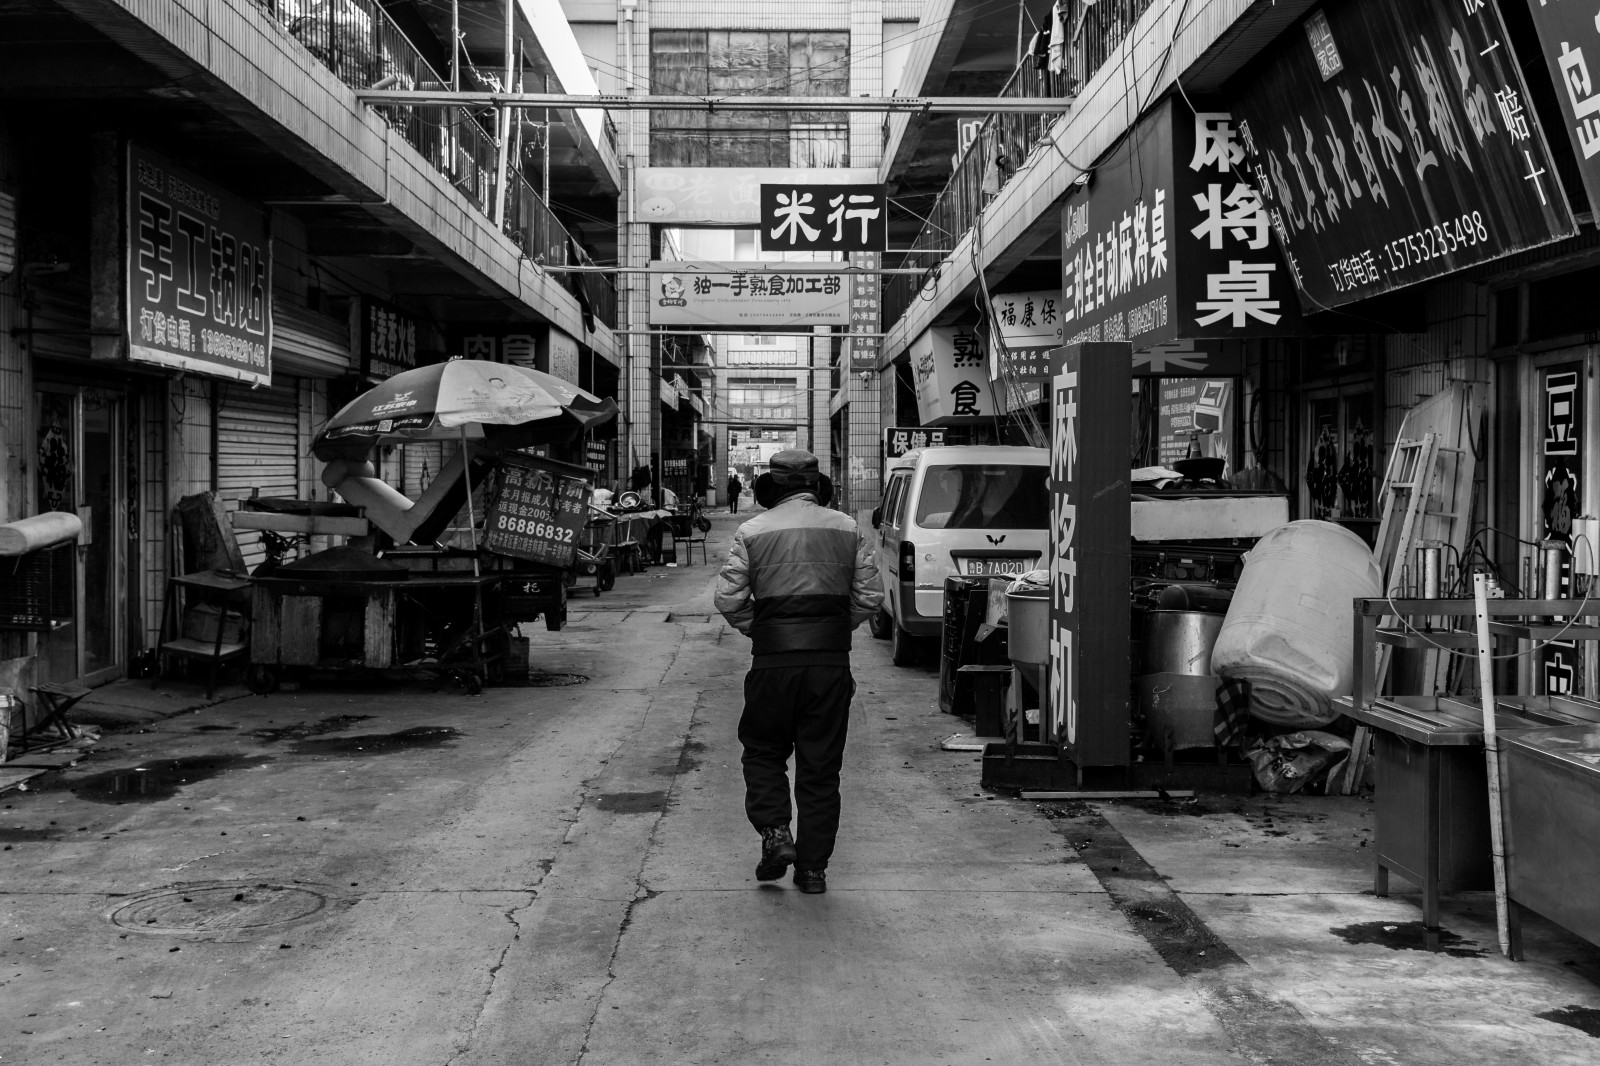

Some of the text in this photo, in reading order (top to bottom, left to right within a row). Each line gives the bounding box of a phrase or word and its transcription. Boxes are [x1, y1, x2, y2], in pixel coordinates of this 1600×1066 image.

[771, 189, 881, 245] 米行
[1188, 112, 1282, 328] 麻将桌
[139, 191, 265, 336] 手工锅贴
[1066, 188, 1167, 322] 三利全自动麻将桌
[693, 275, 841, 297] 独一手熟食加工部
[852, 299, 877, 308] 豆沙包
[857, 286, 875, 296] 包子
[377, 307, 416, 367] 麦香火烧
[852, 312, 877, 321] 小米面
[464, 333, 537, 370] 肉食
[951, 331, 984, 415] 熟食
[1544, 371, 1577, 456] 豆
[892, 430, 945, 454] 保健品
[501, 487, 583, 515] 本月报成人考者
[497, 515, 574, 544] 86886832
[1048, 362, 1078, 744] 麻将机
